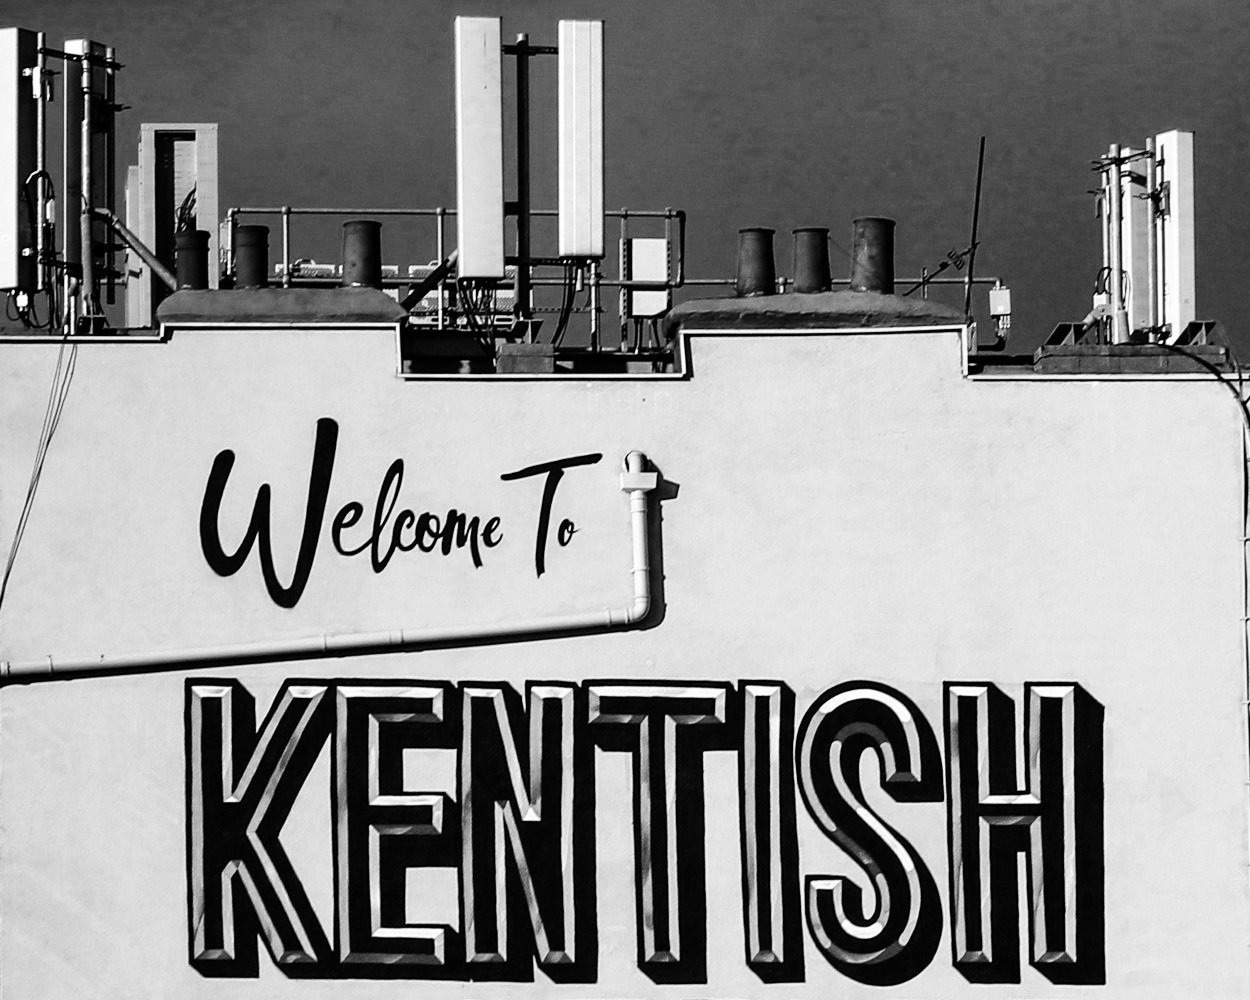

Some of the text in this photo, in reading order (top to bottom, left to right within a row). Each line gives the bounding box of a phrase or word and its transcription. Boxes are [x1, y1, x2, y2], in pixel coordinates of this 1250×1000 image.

[199, 417, 603, 609] Welcome To
[184, 677, 1106, 986] KENTISH
